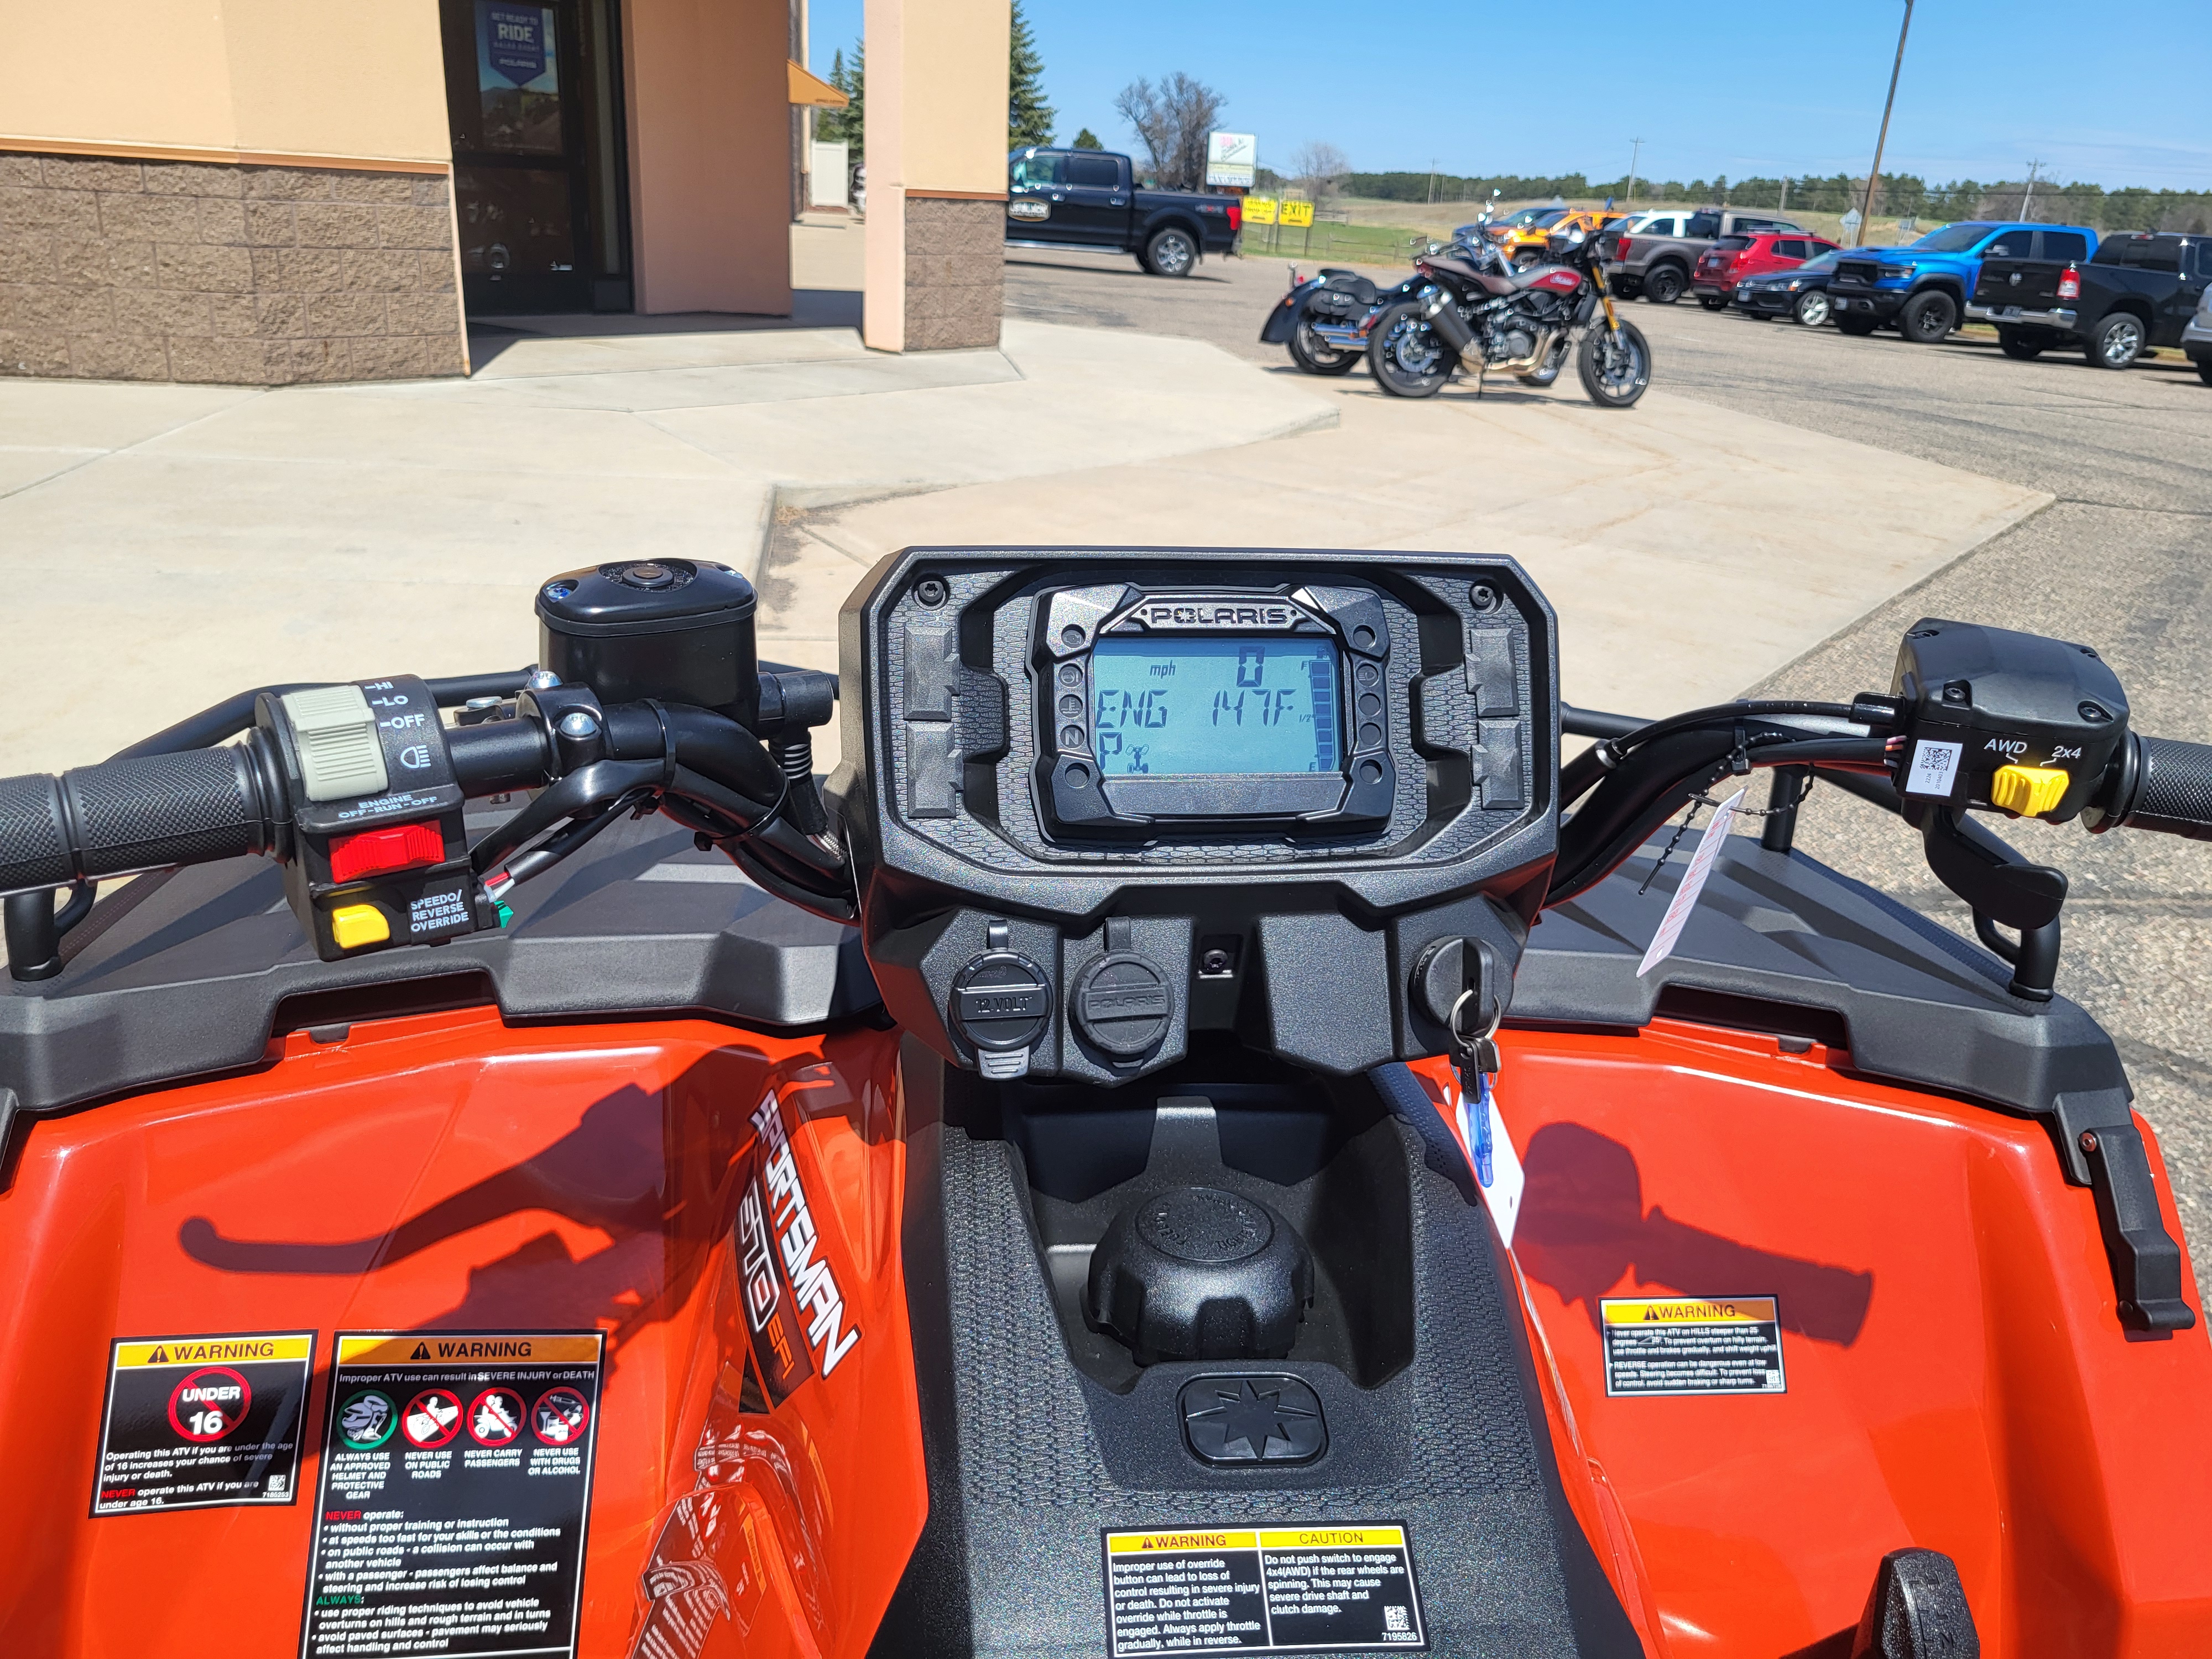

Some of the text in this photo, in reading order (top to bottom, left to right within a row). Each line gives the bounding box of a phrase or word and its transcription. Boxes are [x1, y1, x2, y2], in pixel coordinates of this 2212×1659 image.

[498, 23, 534, 43] RIDE
[1281, 204, 1311, 216] EXIT
[1151, 608, 1287, 624] POLARIS
[1150, 646, 1265, 687] mph 0
[375, 681, 394, 691] HI
[384, 695, 409, 706] LO
[1096, 689, 1297, 728] ENG 147F
[390, 713, 425, 729] OFF
[1065, 731, 1078, 744] N
[1099, 732, 1122, 770] P
[1984, 738, 2028, 754] AWD
[2051, 745, 2083, 759] 2x4
[358, 794, 413, 809] ENGINE
[410, 889, 463, 910] SPEEDO/
[412, 901, 465, 922] REVERSE
[410, 912, 469, 932] OVERRIDE
[993, 997, 1029, 1012] VOLT
[1088, 994, 1165, 1010] POLARIS
[750, 1089, 860, 1378] SPORTSMAN
[739, 1178, 780, 1333] 570
[1659, 1304, 1735, 1318] WARNING
[174, 1342, 274, 1360] WARNING
[438, 1341, 532, 1358] WARNING
[768, 1311, 796, 1380] EFI
[340, 1374, 382, 1384] Improper
[383, 1373, 403, 1382] ATV
[441, 1373, 466, 1381] result
[477, 1371, 517, 1381] SEVERE
[517, 1371, 552, 1380] INJURY
[563, 1370, 594, 1380] DEATH
[182, 1386, 241, 1402] UNDER
[189, 1410, 223, 1435] 16
[106, 1451, 152, 1461] Operating
[153, 1449, 171, 1458] this
[171, 1447, 191, 1457] ATV
[191, 1447, 199, 1455] if
[200, 1447, 217, 1456] you
[262, 1442, 276, 1451] the
[334, 1452, 390, 1462] ALWAYS USE
[105, 1463, 116, 1472] of
[117, 1462, 128, 1470] 16
[129, 1460, 174, 1470] increases
[175, 1458, 197, 1468] your
[197, 1455, 231, 1465] chance
[329, 1462, 391, 1472] AN APPROVED
[103, 1474, 130, 1483] injury
[143, 1470, 173, 1479] death.
[331, 1471, 387, 1481] HELMET AND
[101, 1488, 135, 1499] NEVER
[137, 1486, 175, 1498] operate
[176, 1484, 195, 1493] this
[196, 1482, 216, 1492] ATV
[216, 1481, 224, 1490] if
[225, 1481, 242, 1491] you
[331, 1480, 385, 1490] PROTECTIVE
[346, 1490, 371, 1500] GEAR
[100, 1500, 128, 1510] under
[129, 1498, 149, 1508] age
[325, 1510, 404, 1522] NEVER operate:
[1155, 1535, 1227, 1548] WARNING
[1299, 1532, 1363, 1544] CAUTION
[1113, 1558, 1226, 1574] Improper use of override
[1264, 1553, 1397, 1566] Do not push switch to engage
[1113, 1570, 1230, 1585] button can lead to loss of
[1266, 1564, 1405, 1578] 4x4(AWD) if the rear wheels are
[1114, 1582, 1260, 1598] control resulting in severe injury
[1267, 1578, 1381, 1592] spinning. This may cause
[316, 1595, 364, 1605] ALWAYS:
[1115, 1595, 1230, 1611] or death. Do not activate
[1269, 1589, 1370, 1602] severe drive shaft and
[1116, 1608, 1228, 1624] override while throttle is
[1271, 1603, 1342, 1615] clutch damage.
[1117, 1620, 1261, 1637] engaged. Always apply throttle
[1118, 1636, 1243, 1651] gradually, while in reverse.
[1939, 1632, 1954, 1651] N
